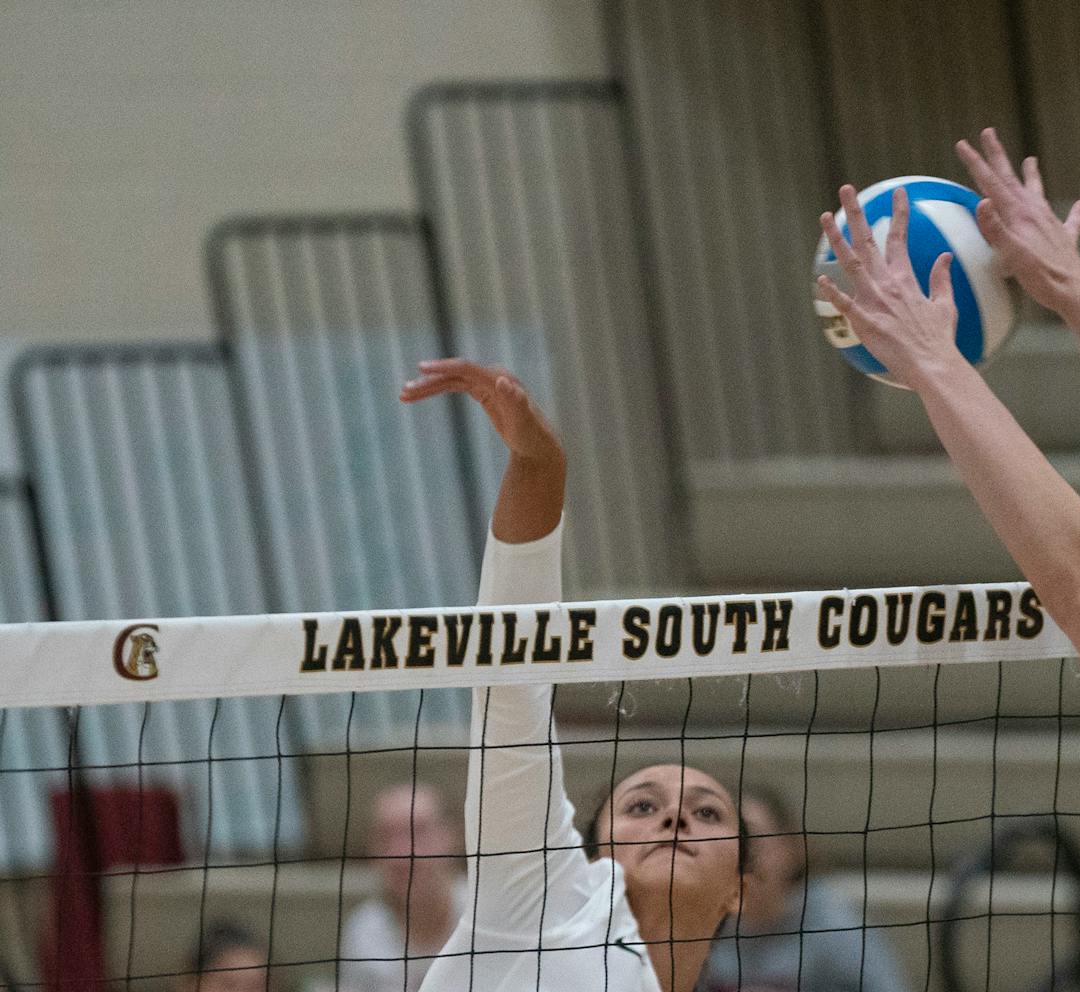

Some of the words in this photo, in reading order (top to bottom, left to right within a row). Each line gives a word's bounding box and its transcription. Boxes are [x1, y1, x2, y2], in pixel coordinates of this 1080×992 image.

[300, 608, 596, 674] LAKEVILLE
[622, 600, 794, 660] SOUTH
[818, 589, 1045, 648] COUGARS
